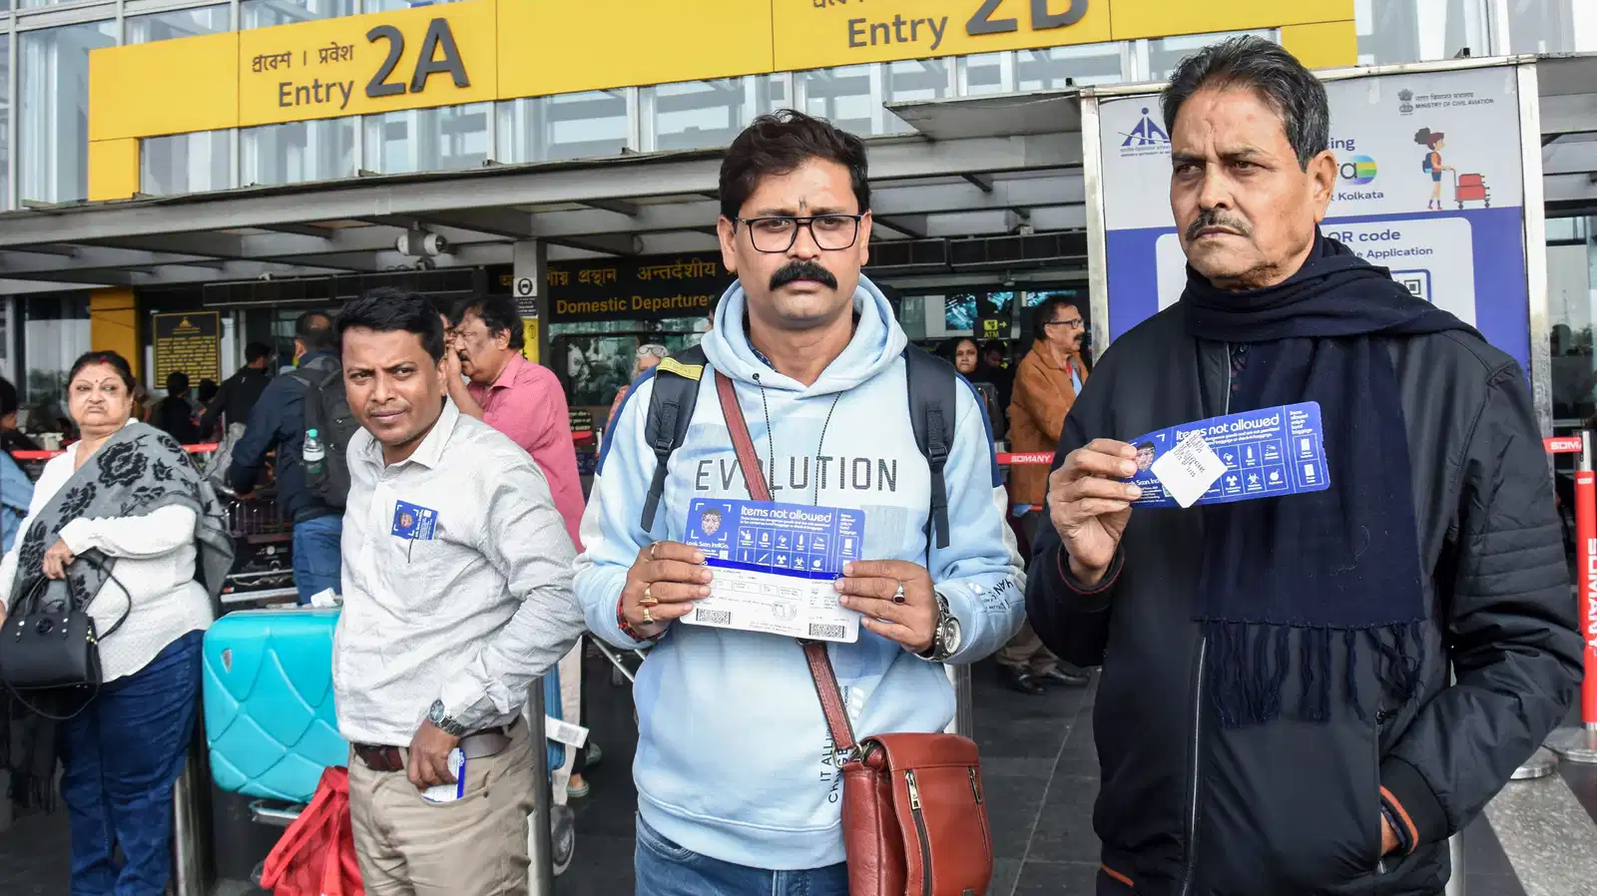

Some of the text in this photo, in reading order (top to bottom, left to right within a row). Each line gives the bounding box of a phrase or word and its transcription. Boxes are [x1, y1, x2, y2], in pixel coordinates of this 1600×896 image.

[848, 14, 948, 50] Entry
[319, 42, 354, 64] प्रवेश
[279, 18, 470, 110] Entry 2A
[1328, 138, 1355, 151] ing
[1338, 191, 1384, 201] Kolkata
[1359, 229, 1401, 241] code
[1367, 247, 1433, 259] Application
[557, 299, 627, 314] Domestic
[1209, 424, 1229, 434] not
[1230, 413, 1280, 432] allowed
[1011, 454, 1050, 462] SOMANY
[696, 456, 897, 492] EVLUTION
[741, 505, 768, 516] Items
[770, 509, 789, 518] not
[789, 510, 832, 522] allowed
[820, 770, 832, 782] IT
